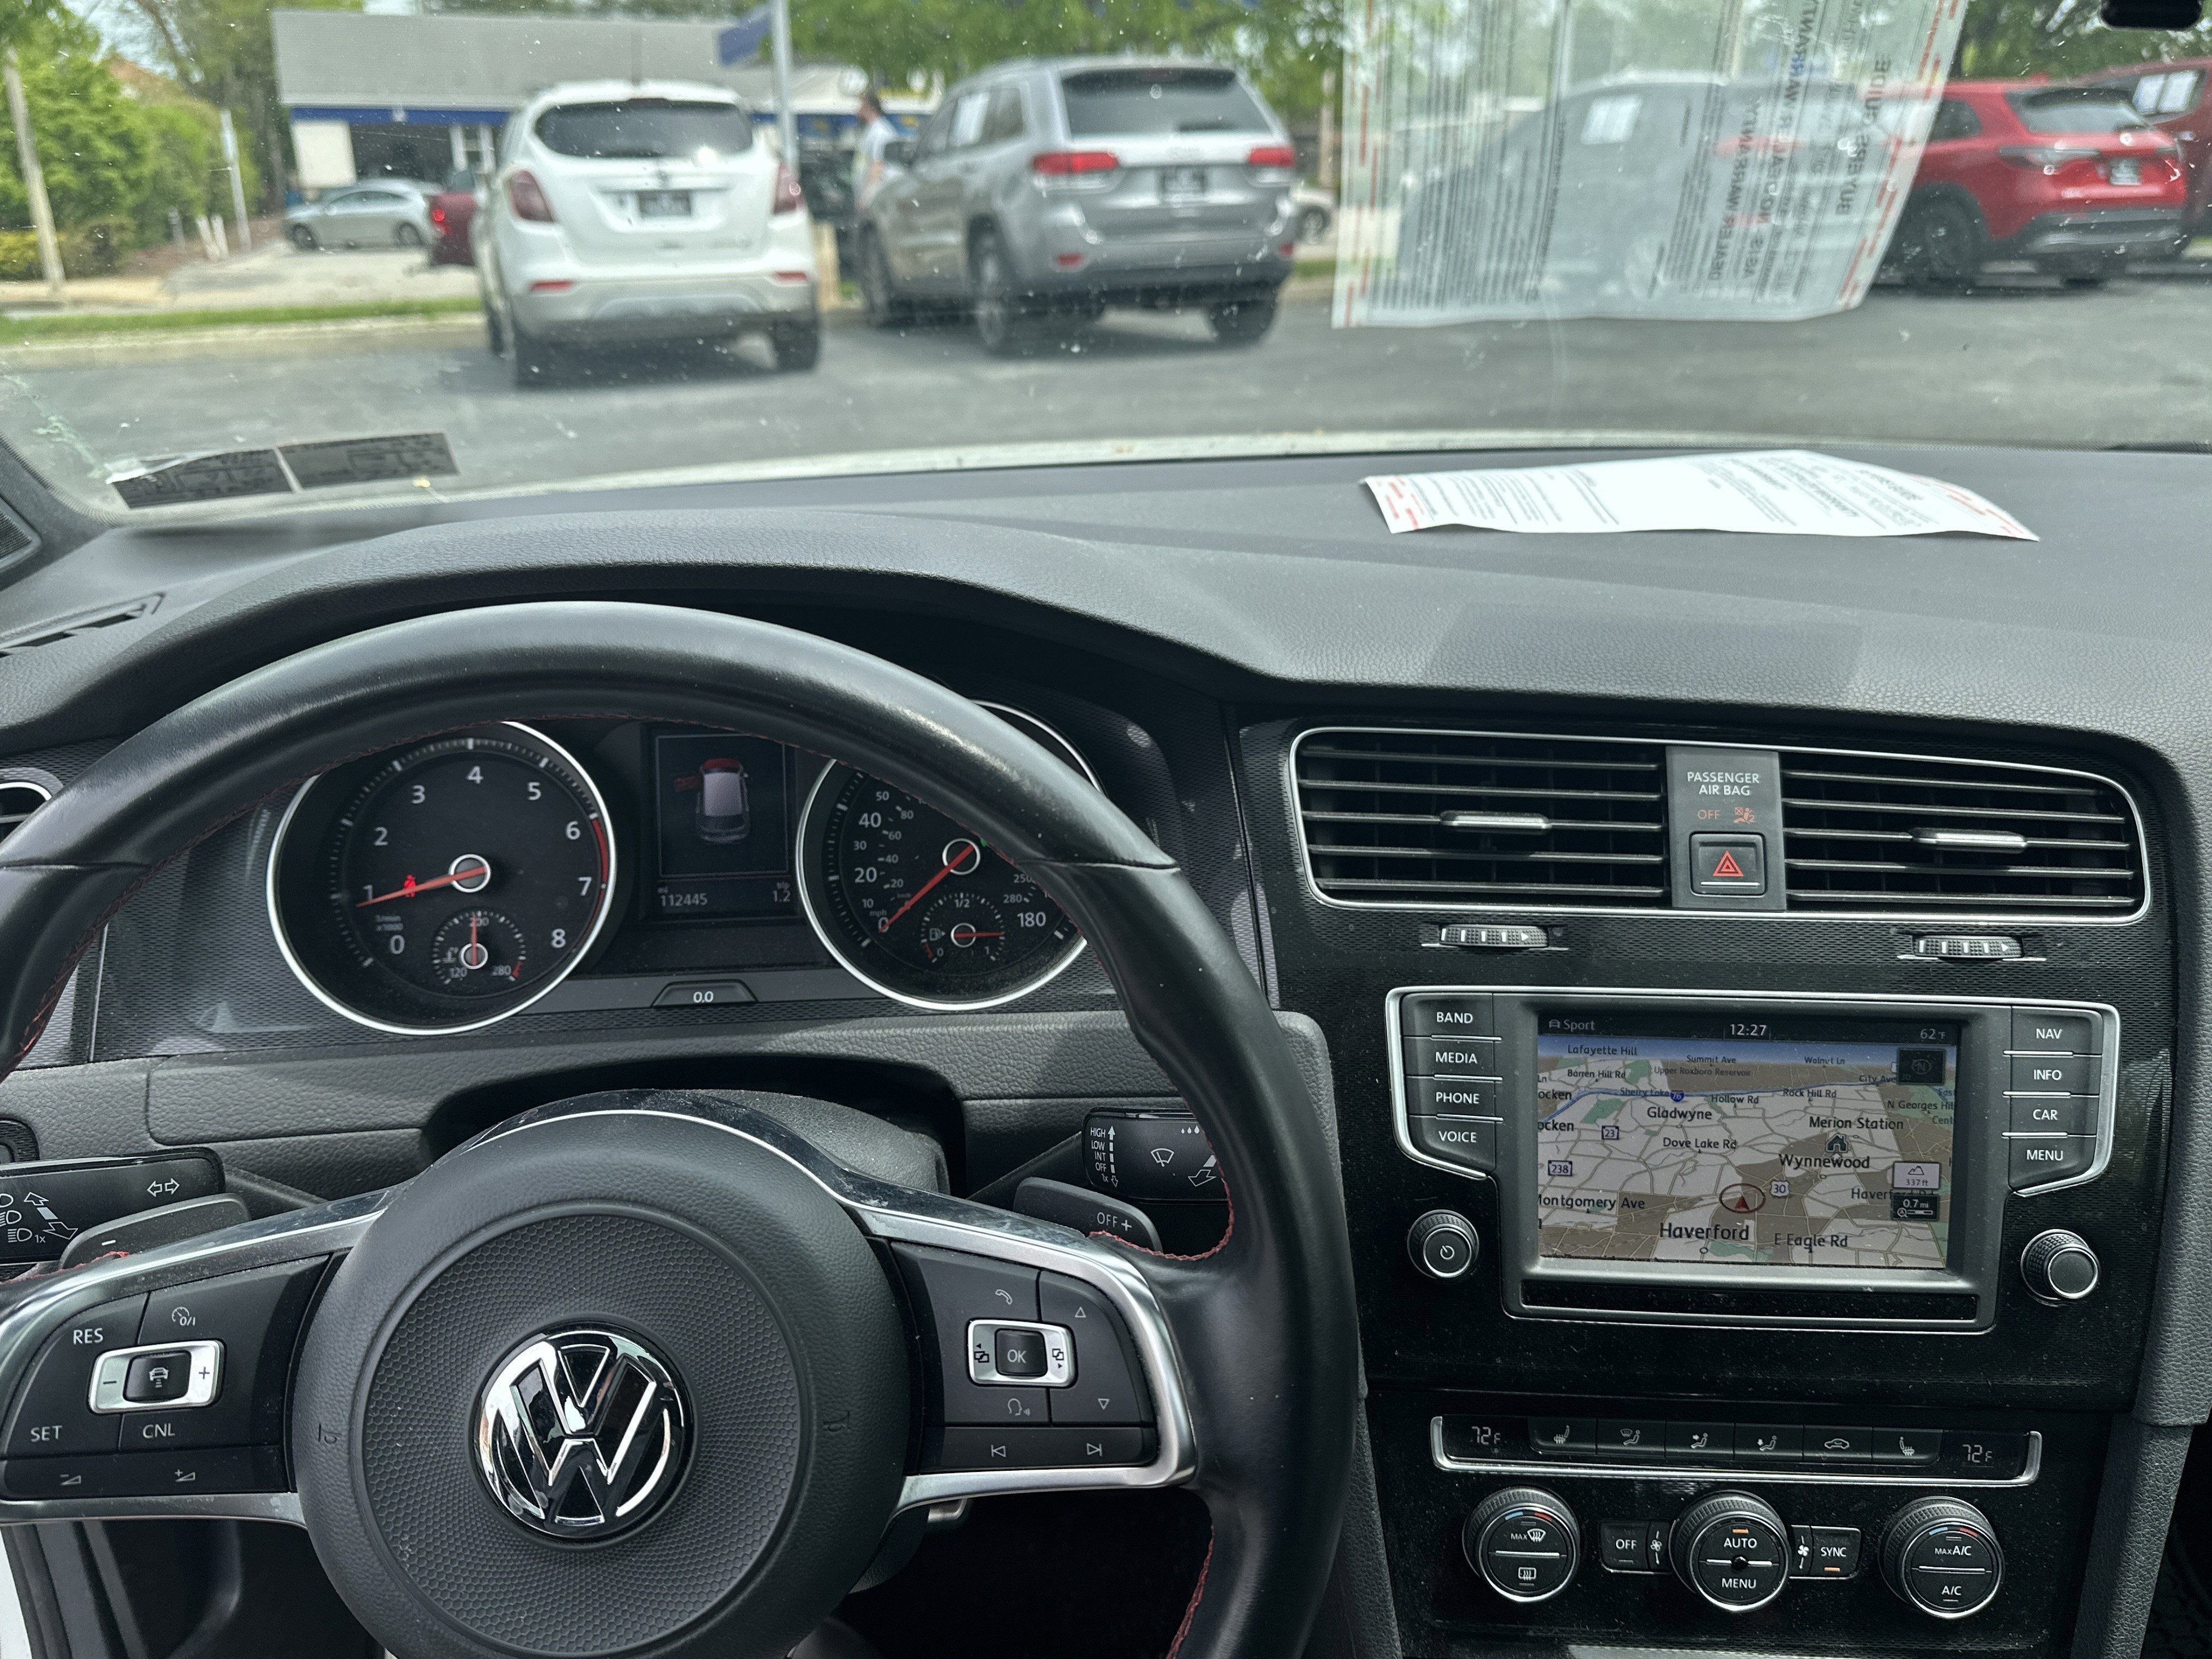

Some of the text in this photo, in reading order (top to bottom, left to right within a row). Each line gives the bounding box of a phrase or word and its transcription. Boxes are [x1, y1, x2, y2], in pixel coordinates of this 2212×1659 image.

[467, 766, 483, 783] 4
[1687, 771, 1759, 783] PASSENGER
[411, 785, 425, 804] 3
[528, 782, 541, 800] 5
[1699, 785, 1750, 795] AIR BAG
[876, 791, 889, 801] 50
[859, 811, 882, 828] 40
[901, 810, 913, 820] 80
[1697, 809, 1720, 820] OFF
[566, 821, 580, 840] 6
[888, 831, 901, 840] 60
[375, 827, 388, 846] 2
[853, 840, 867, 850] 30
[885, 854, 899, 864] 40
[854, 867, 877, 883] 20
[1013, 874, 1032, 883] 250
[579, 878, 592, 896] 7
[890, 878, 904, 888] 20
[363, 884, 374, 901] 1
[773, 889, 791, 902] 1.2
[661, 893, 708, 907] 112445
[861, 898, 874, 909] 10
[954, 899, 970, 909] 1/2
[1003, 894, 1022, 904] 280
[1017, 912, 1046, 927] 180
[551, 929, 566, 948] 8
[390, 935, 405, 955] 0
[936, 947, 944, 957] 0
[450, 967, 467, 978] 120
[492, 965, 511, 976] 280
[693, 991, 714, 1003] 0.0
[1436, 1012, 1474, 1024] BAND
[1564, 1019, 1595, 1032] Sport
[1730, 1024, 1767, 1036] 12:27
[1920, 1028, 1936, 1040] 62
[2036, 1028, 2062, 1039] NAV
[1568, 1045, 1637, 1056] Lafayette Hill
[1435, 1052, 1477, 1064] MEDIA
[1686, 1055, 1718, 1063] Summit
[1804, 1056, 1833, 1064] Walnut
[1567, 1069, 1595, 1078] Barren
[1654, 1066, 1677, 1075] Upper
[1715, 1068, 1751, 1076] Reservoir
[2034, 1069, 2062, 1081] INFO
[1859, 1075, 1877, 1084] City
[1620, 1087, 1647, 1097] Sherry
[1783, 1089, 1804, 1097] Rock
[1825, 1090, 1836, 1098] Rd
[1436, 1092, 1480, 1104] PHONE
[1711, 1094, 1759, 1104] Hollow Rd
[1887, 1100, 1894, 1108] N
[1899, 1101, 1938, 1111] Georges
[1647, 1107, 1712, 1121] Gladwyne
[2033, 1109, 2057, 1120] CAR
[1809, 1116, 1903, 1130] Merion Station
[1090, 1127, 1106, 1138] HIGH
[1438, 1131, 1477, 1143] VOICE
[1605, 1130, 1615, 1138] 23
[1091, 1140, 1105, 1150] LOW
[1663, 1138, 1737, 1149] Dove Lake Rd
[1094, 1151, 1106, 1161] INT
[2027, 1149, 2063, 1161] MENU
[1095, 1162, 1107, 1172] OFF
[1779, 1154, 1870, 1170] Wynnewood
[1551, 1164, 1568, 1173] 238
[1101, 1173, 1109, 1182] 1x
[1774, 1184, 1786, 1193] 30
[1621, 1198, 1645, 1208] Ave
[1903, 1199, 1918, 1207] 0.7
[1097, 1212, 1118, 1228] OFF
[1660, 1222, 1749, 1240] Haverford
[34, 1232, 47, 1244] 1x
[1775, 1233, 1848, 1250] E Eagle Rd
[72, 1328, 104, 1345] RES
[1007, 1348, 1026, 1363] OK
[30, 1425, 63, 1443] SET
[142, 1423, 175, 1439] CNL
[1615, 1539, 1637, 1550] OFF
[1723, 1538, 1757, 1549] AUTO
[1821, 1547, 1847, 1557] SYNC
[1722, 1578, 1756, 1589] MENU
[1942, 1585, 1962, 1596] A/C
